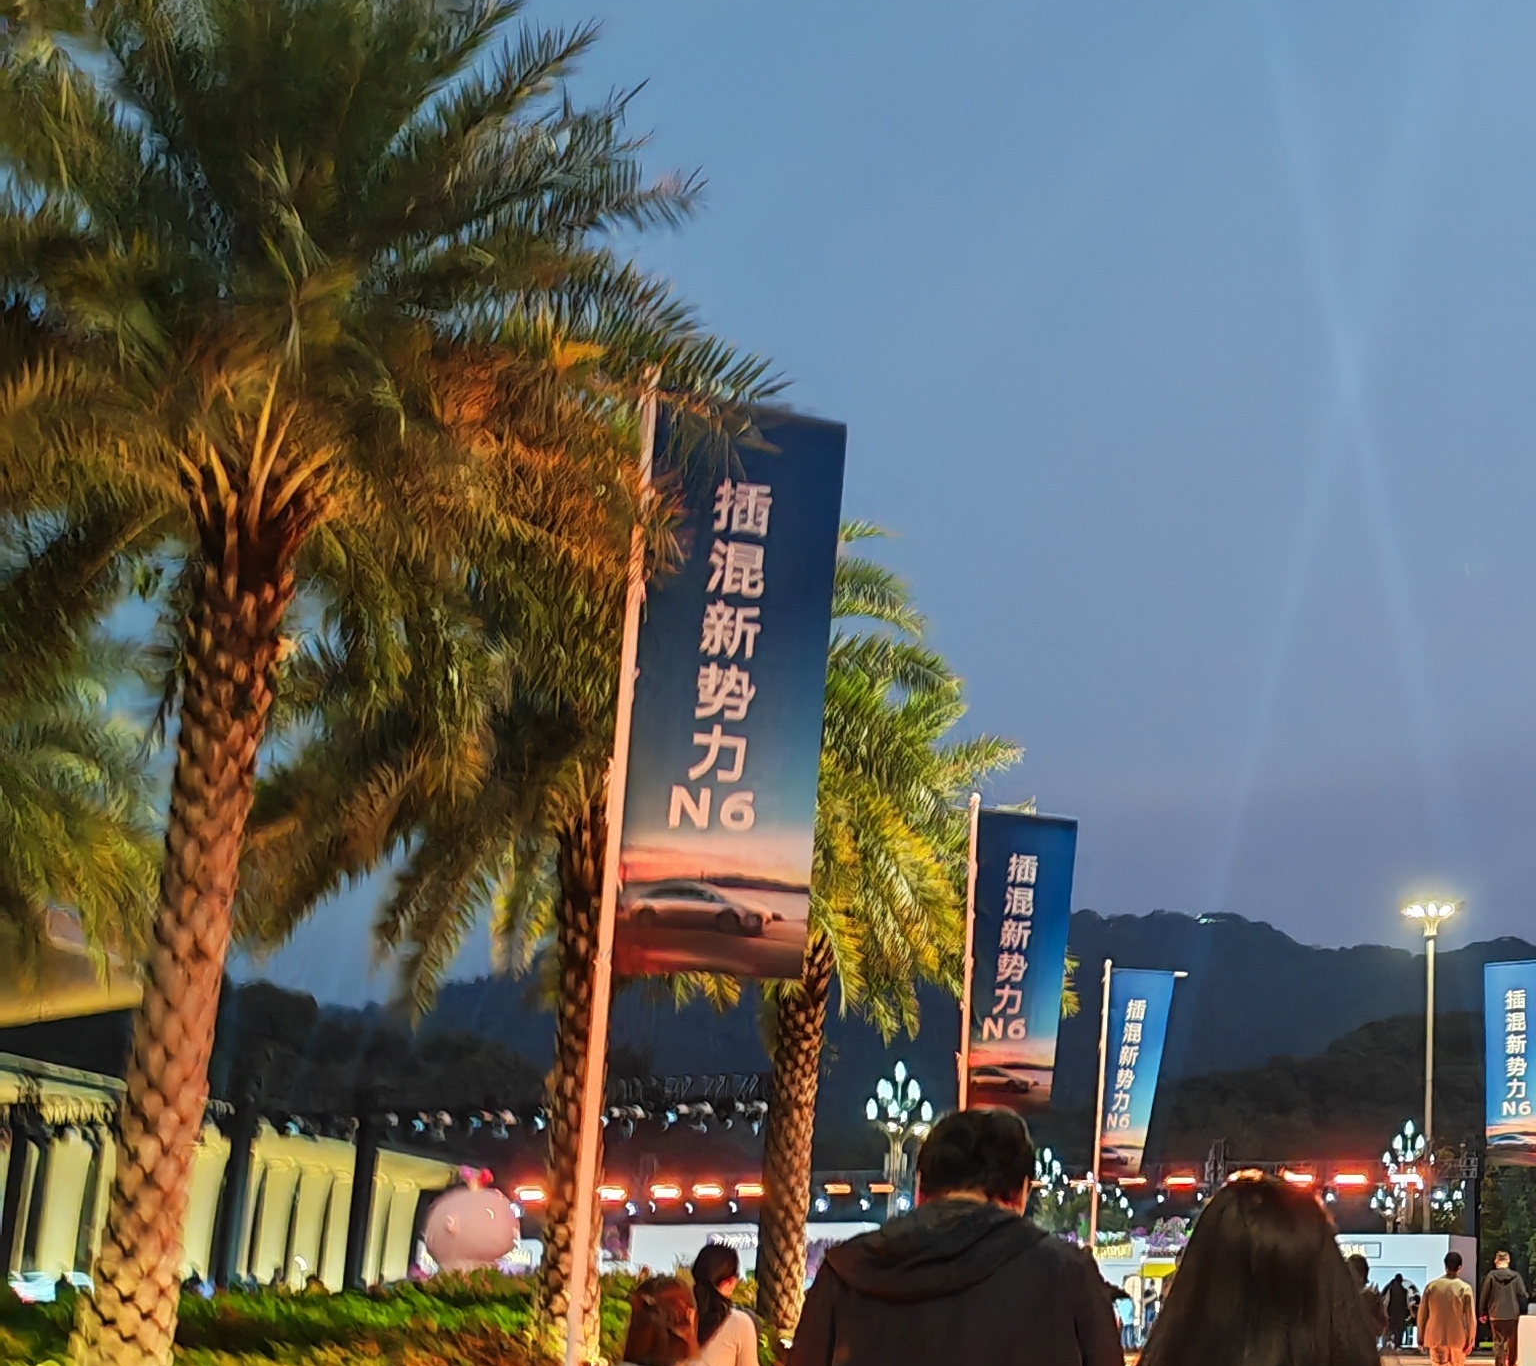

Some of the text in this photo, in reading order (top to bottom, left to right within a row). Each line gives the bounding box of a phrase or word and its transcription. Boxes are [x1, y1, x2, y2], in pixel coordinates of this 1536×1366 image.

[688, 477, 773, 783] 插混新势力
[668, 783, 757, 834] N6
[992, 852, 1039, 1016] 插混新势力
[981, 1016, 1027, 1042] N6
[1111, 998, 1148, 1112] 插混新势力
[1504, 988, 1528, 1100] 插混新势力
[1106, 1111, 1131, 1131] N6
[1502, 1100, 1533, 1117] N6
